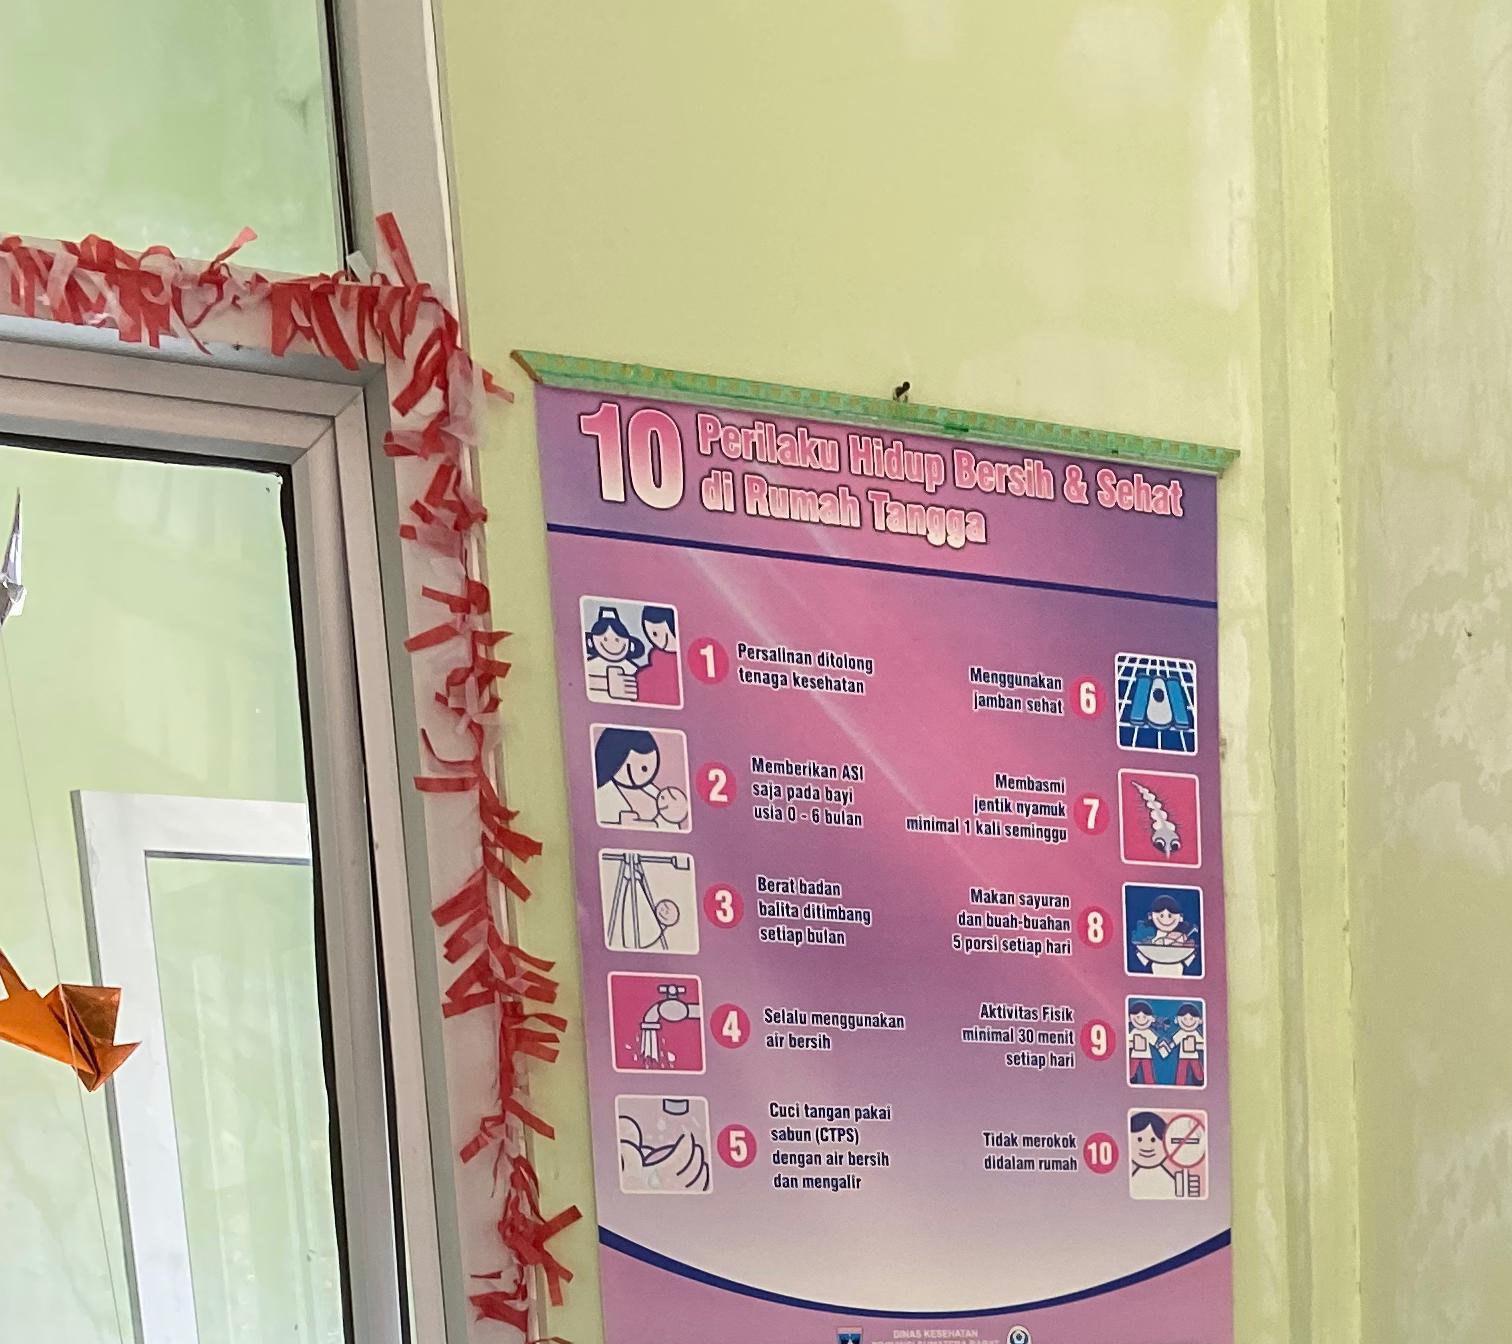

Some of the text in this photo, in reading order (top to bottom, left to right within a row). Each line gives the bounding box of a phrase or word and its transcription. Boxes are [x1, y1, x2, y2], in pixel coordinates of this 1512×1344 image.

[580, 402, 684, 509] 10
[696, 413, 1183, 518] Perilaku Hidup Bersih & Sehat
[701, 470, 986, 549] di Rumah Tangga
[698, 646, 717, 679] 1
[737, 643, 873, 675] Persalinan ditolong
[738, 667, 864, 694] tenaga kesehatan
[970, 667, 1062, 690] Menggunakan
[974, 692, 1063, 714] jamban sehat
[1080, 682, 1096, 714] 6
[751, 757, 864, 781] Memberikan ASI
[709, 769, 727, 802] 2
[752, 783, 853, 806] saja pada bayi
[995, 773, 1065, 794] Membasmi
[754, 805, 783, 821] usia
[787, 806, 796, 822] 0
[811, 808, 820, 824] 6
[824, 809, 862, 826] bulan
[974, 798, 1066, 818] jentik nyamuk
[1082, 798, 1098, 828] 7
[906, 818, 1067, 843] minimal 1 kali seminggu
[757, 876, 841, 896] Berat badan
[715, 890, 733, 922] 3
[970, 888, 1070, 910] Makan sayuran
[758, 901, 871, 926] balita ditimbang
[958, 911, 1071, 931] dan buah-buahan
[760, 926, 845, 946] setiap bulan
[1087, 911, 1104, 943] 8
[953, 934, 1071, 956] 5 porsi setiap hari
[764, 1008, 904, 1030] Selalu menggunakan
[980, 1003, 1073, 1022] Aktivitas Fisik
[722, 1011, 741, 1042] 4
[962, 1027, 1074, 1045] minimal 30 menit
[766, 1033, 831, 1049] air bersih
[1091, 1024, 1107, 1054] 9
[1006, 1051, 1074, 1070] setiap hari
[769, 1102, 891, 1123] Cuci tangan pakai
[729, 1130, 748, 1161] 5
[770, 1126, 859, 1146] sabun (CTPS)
[983, 1132, 1076, 1148] Tidak merokok
[772, 1151, 890, 1168] dengan air bersih
[984, 1155, 1079, 1173] didalam rumah
[1088, 1142, 1112, 1165] 10
[773, 1173, 862, 1192] dan mengalir
